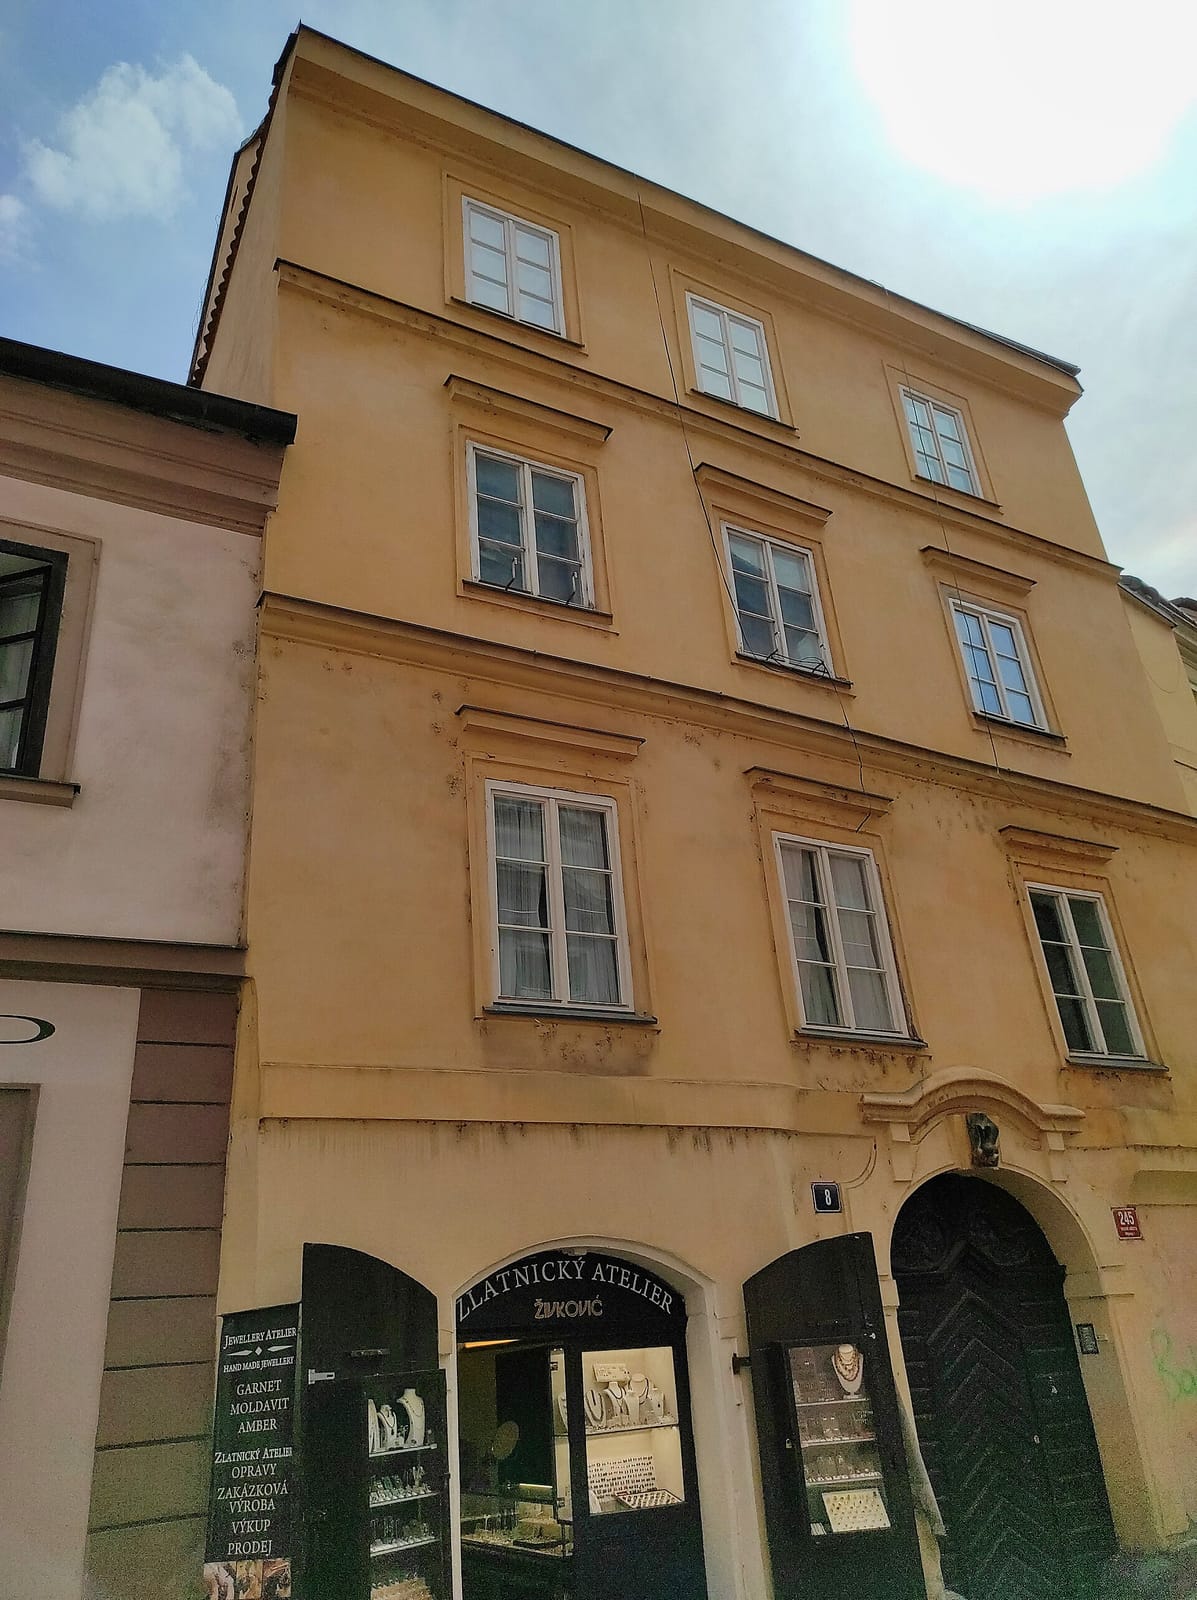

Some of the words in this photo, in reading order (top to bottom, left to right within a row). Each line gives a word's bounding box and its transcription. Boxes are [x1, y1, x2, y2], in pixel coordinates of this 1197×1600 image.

[824, 1189, 832, 1206] 8
[1117, 1211, 1135, 1225] 245
[455, 1256, 586, 1323] ZLATNICKÝ
[591, 1262, 673, 1315] ATELIER
[222, 1332, 266, 1350] JEWELLERY
[265, 1327, 297, 1341] ATELIER
[223, 1363, 243, 1373] HAND
[242, 1360, 261, 1371] MADE
[260, 1356, 295, 1371] JEWELLERY
[236, 1379, 282, 1396] GARNET
[230, 1397, 290, 1416] MOLDAVIT
[238, 1418, 278, 1434] AMBER
[214, 1447, 261, 1464] ZLATNICKÝ
[231, 1462, 277, 1479] OPRAVY
[217, 1479, 289, 1500] ZAKÁZKOVÁ
[229, 1497, 277, 1514] VÝROBA
[231, 1517, 271, 1534] VÝKUP
[227, 1539, 273, 1557] PRODEJ
